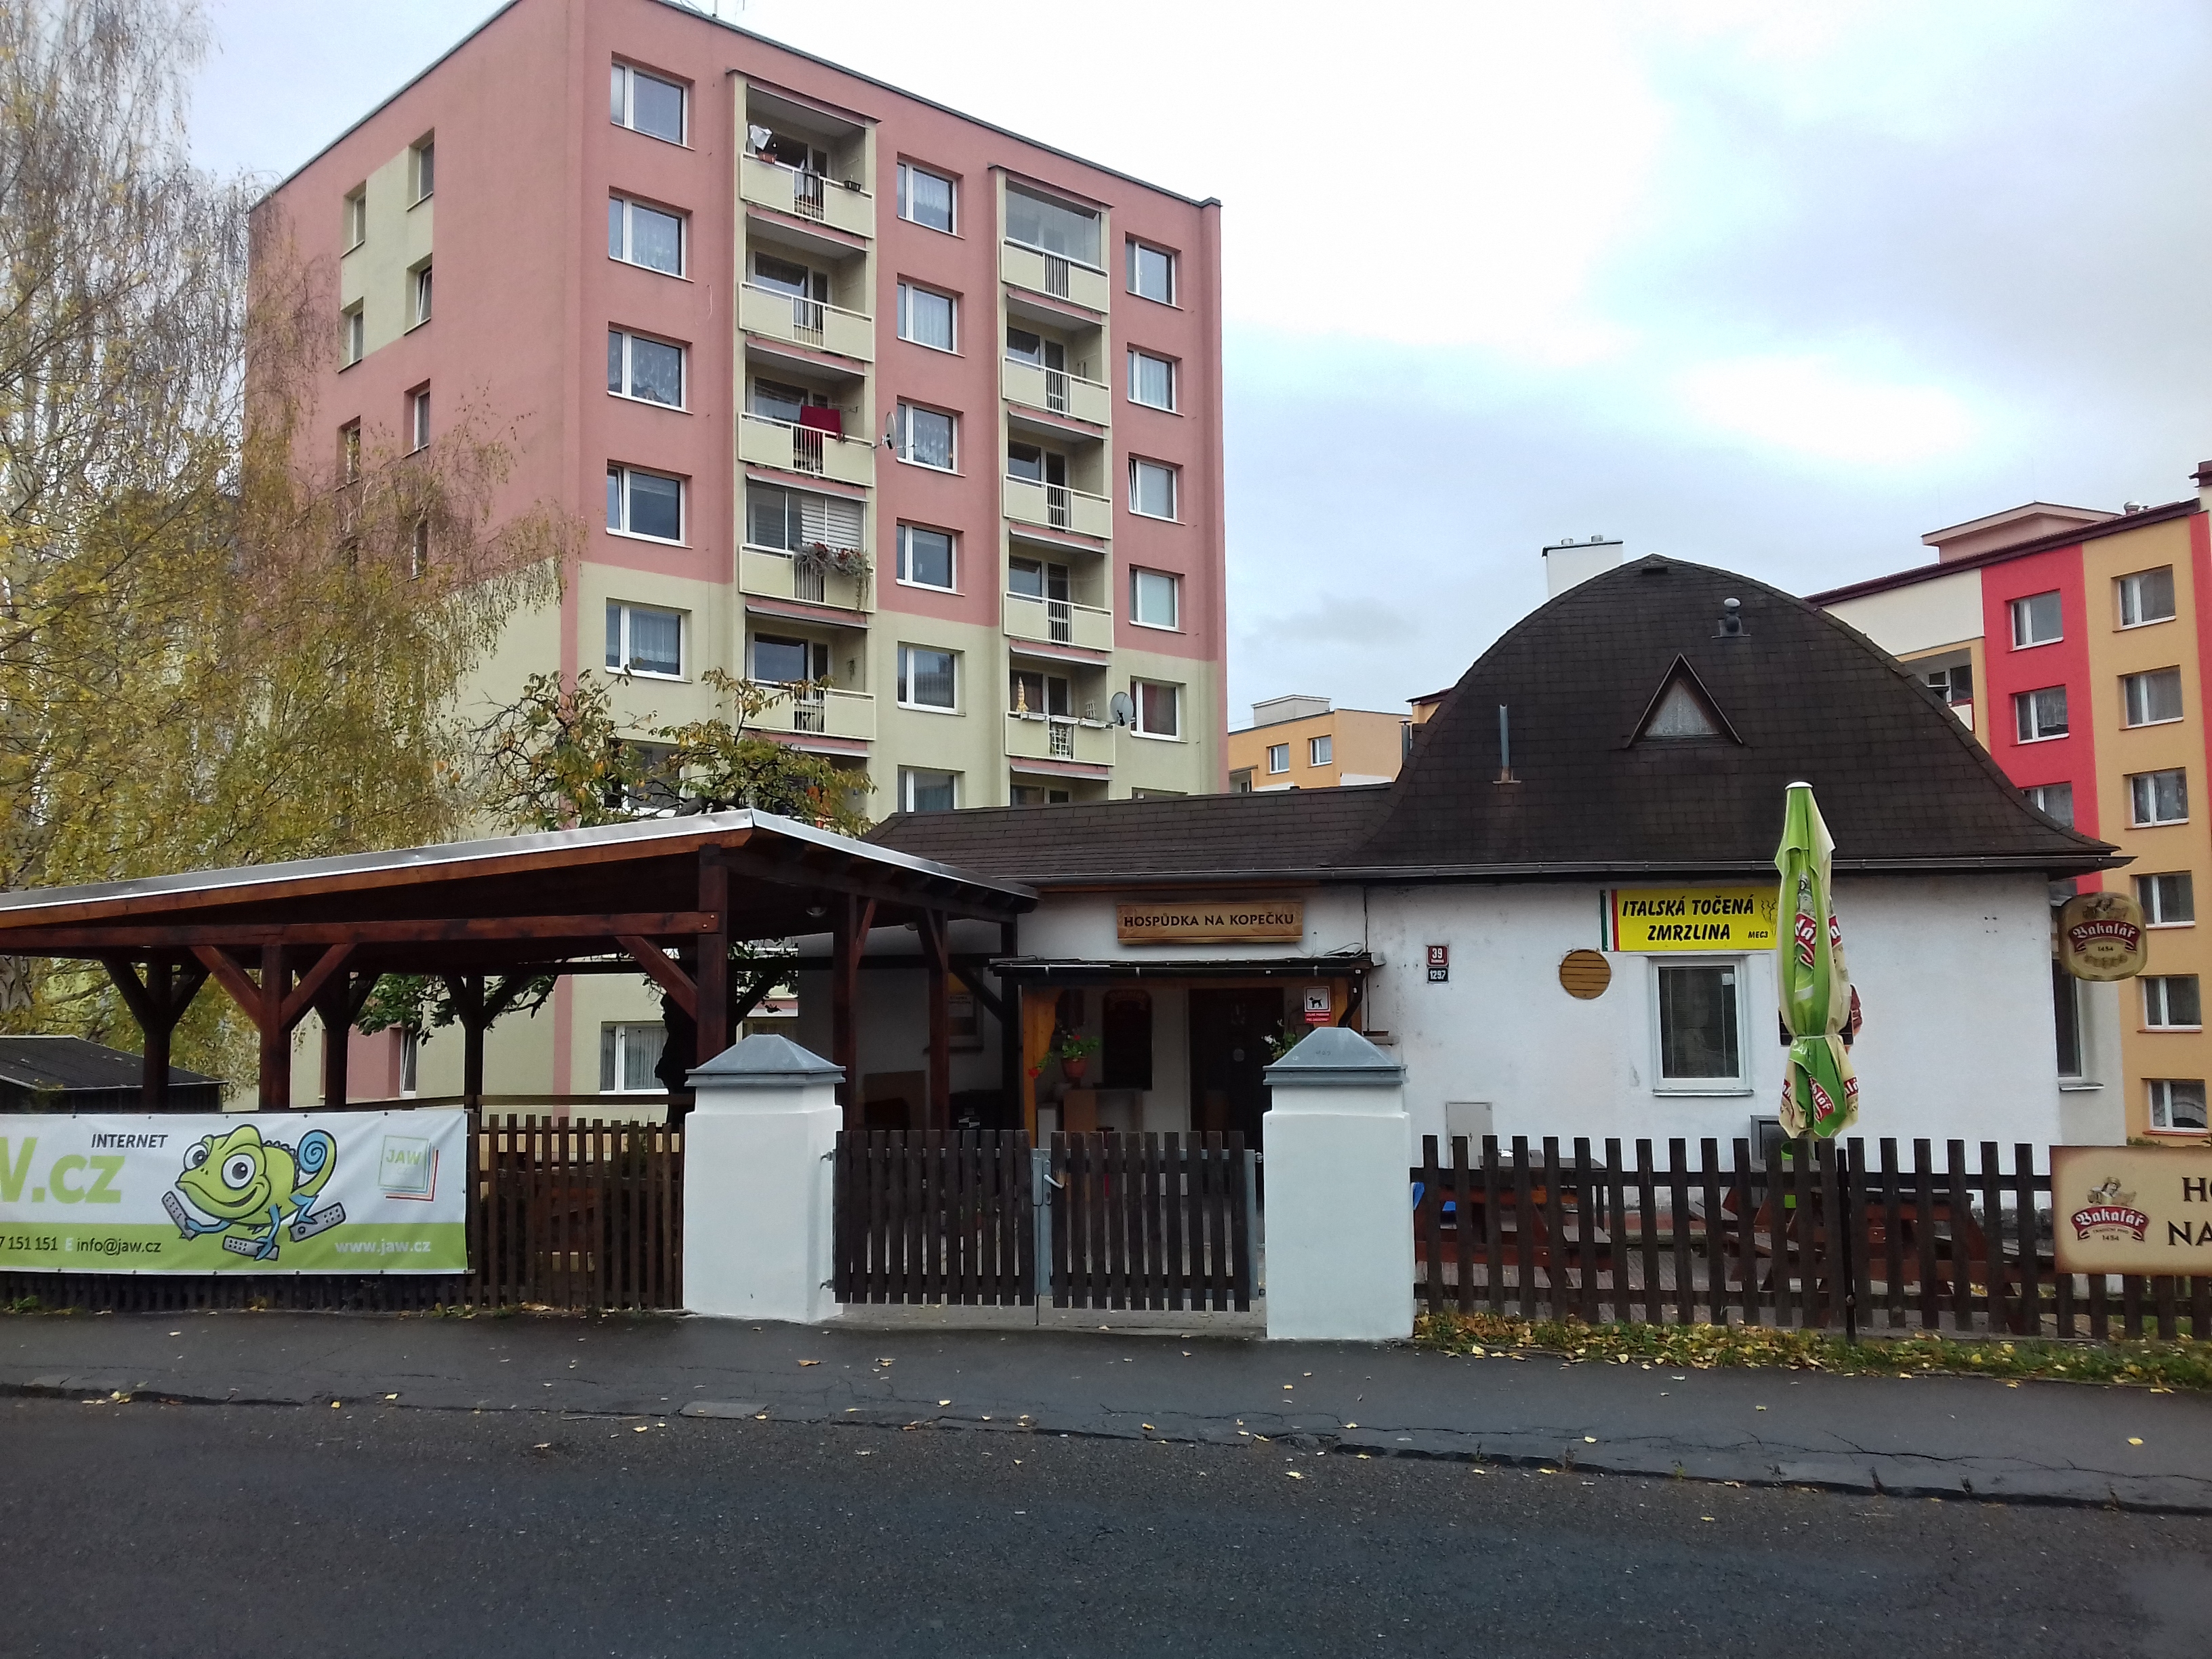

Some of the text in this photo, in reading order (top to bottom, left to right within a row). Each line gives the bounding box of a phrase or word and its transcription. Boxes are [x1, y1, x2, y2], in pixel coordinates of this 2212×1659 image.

[1622, 894, 1755, 917] ITALSKÁ TOČENÁ
[1124, 912, 1294, 927] HOSPŮDKA NA KOPEČKU
[1647, 924, 1731, 942] ZMRZLINA
[2072, 922, 2136, 938] Bakalář
[1431, 947, 1443, 959] 39
[1429, 969, 1446, 980] 1297
[91, 1133, 169, 1149] INTERNET
[386, 1149, 420, 1166] JAW
[2182, 1176, 2212, 1202] H
[2075, 1208, 2144, 1226] Bakalář
[8, 1237, 30, 1250] 151
[35, 1237, 58, 1251] 151
[77, 1236, 162, 1256] info@jaw.cz
[335, 1238, 431, 1256] www.jaw.cz
